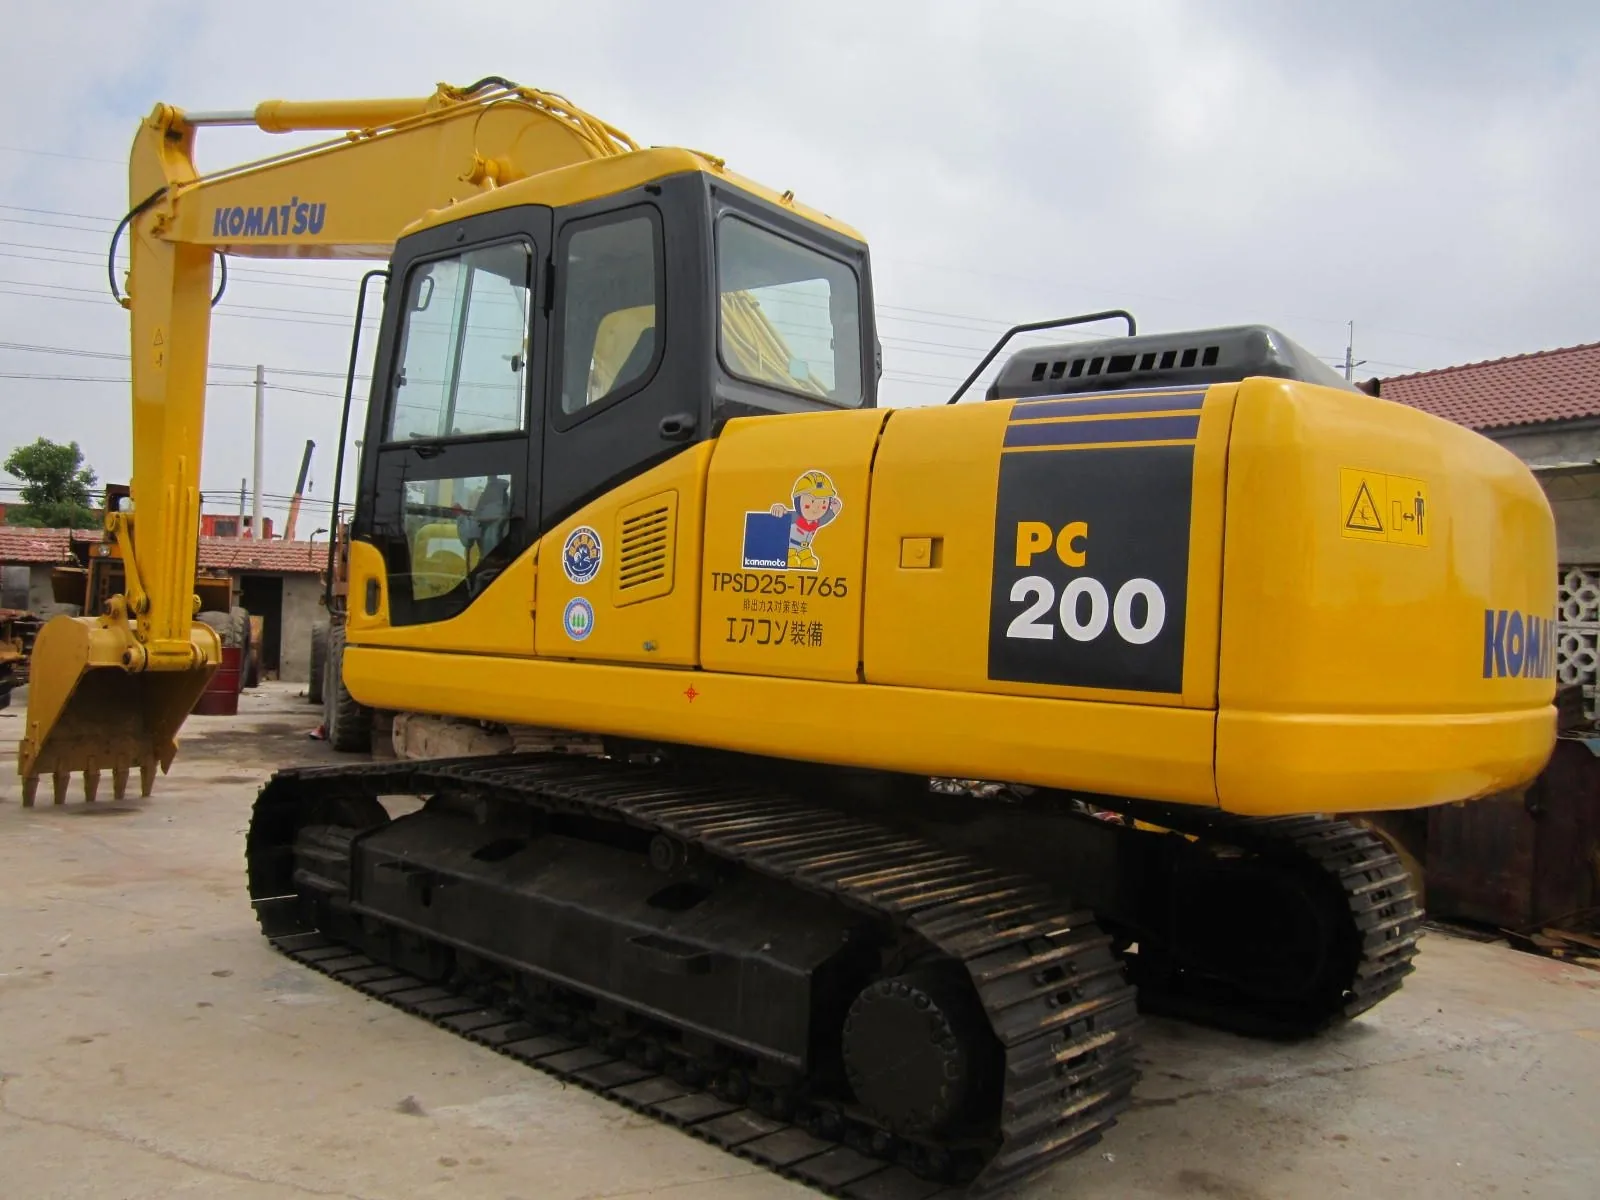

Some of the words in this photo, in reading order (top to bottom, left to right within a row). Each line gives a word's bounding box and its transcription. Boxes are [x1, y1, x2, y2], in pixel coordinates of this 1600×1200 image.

[212, 196, 326, 237] KOMATSU
[744, 557, 786, 568] kanamoto
[1015, 521, 1088, 567] PC
[712, 572, 848, 598] TPSD25-1765
[1006, 575, 1166, 645] 200
